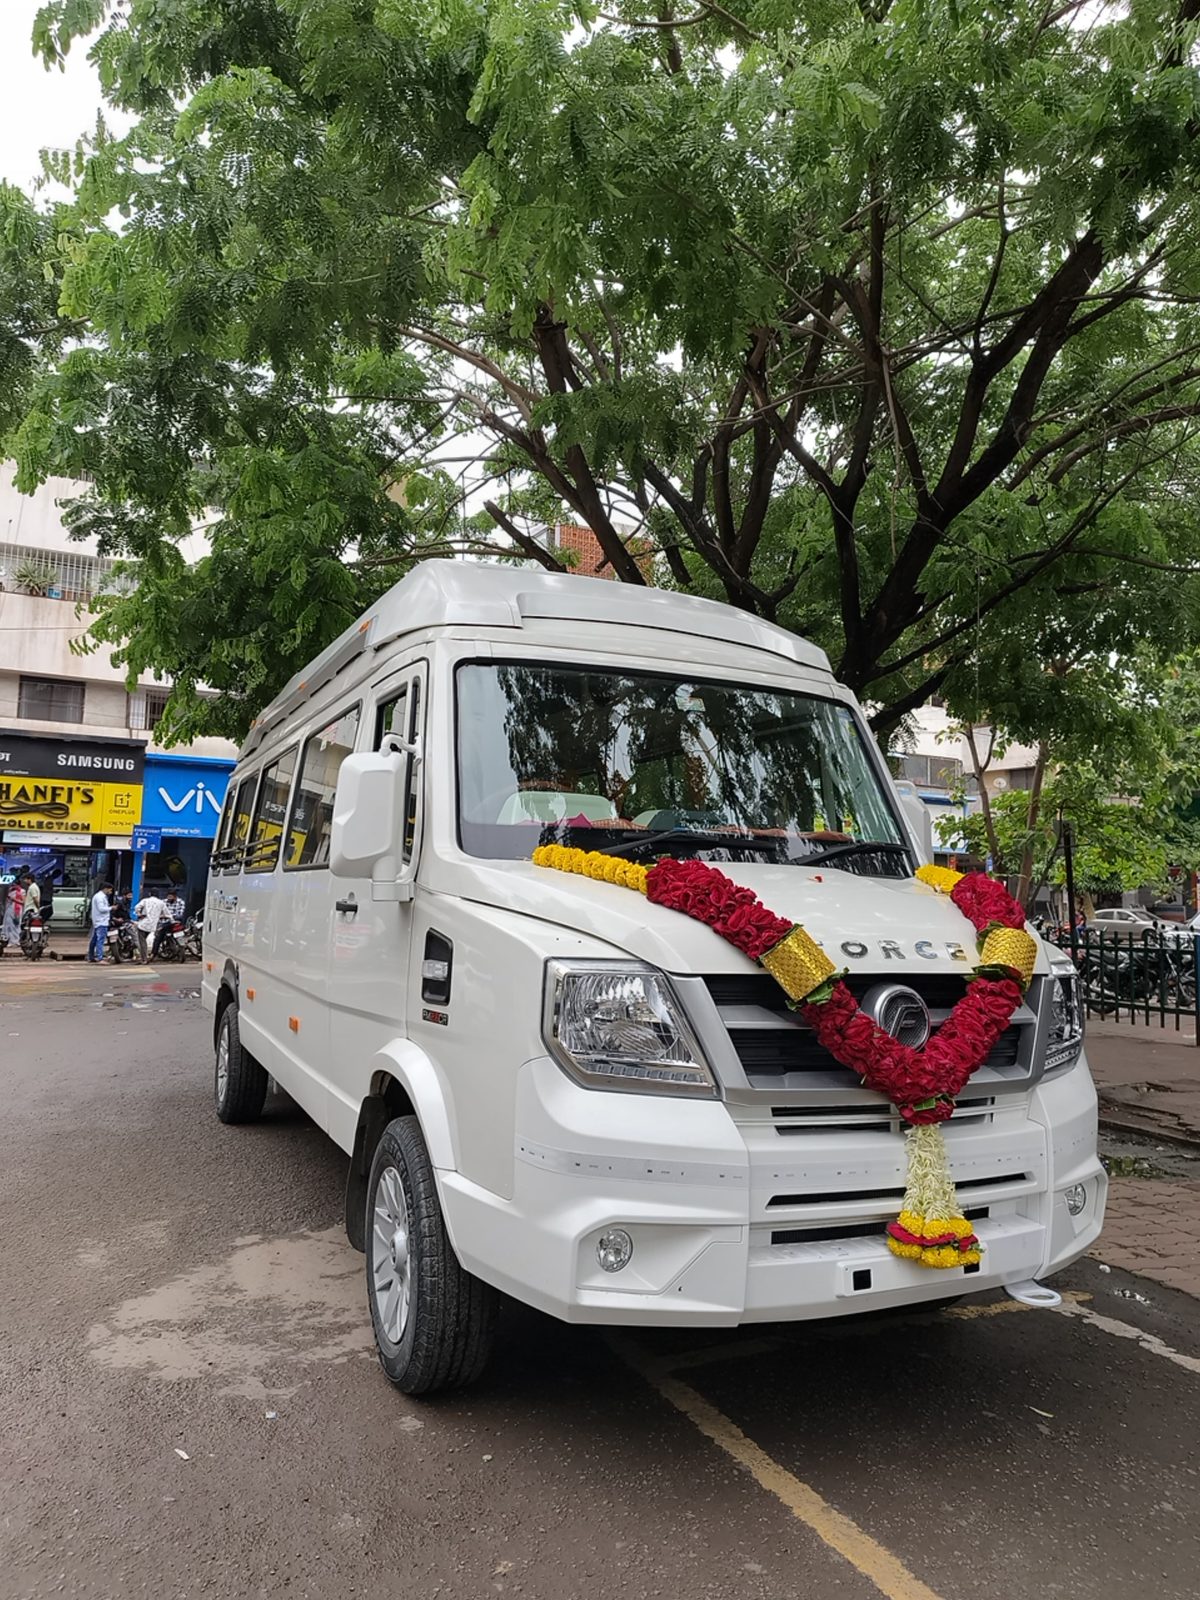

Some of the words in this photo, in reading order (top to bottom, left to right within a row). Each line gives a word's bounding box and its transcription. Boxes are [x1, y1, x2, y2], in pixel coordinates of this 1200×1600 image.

[57, 754, 135, 770] SAMSUNG
[0, 819, 91, 831] COLLECTION
[136, 837, 148, 849] P
[840, 940, 967, 961] ORCE
